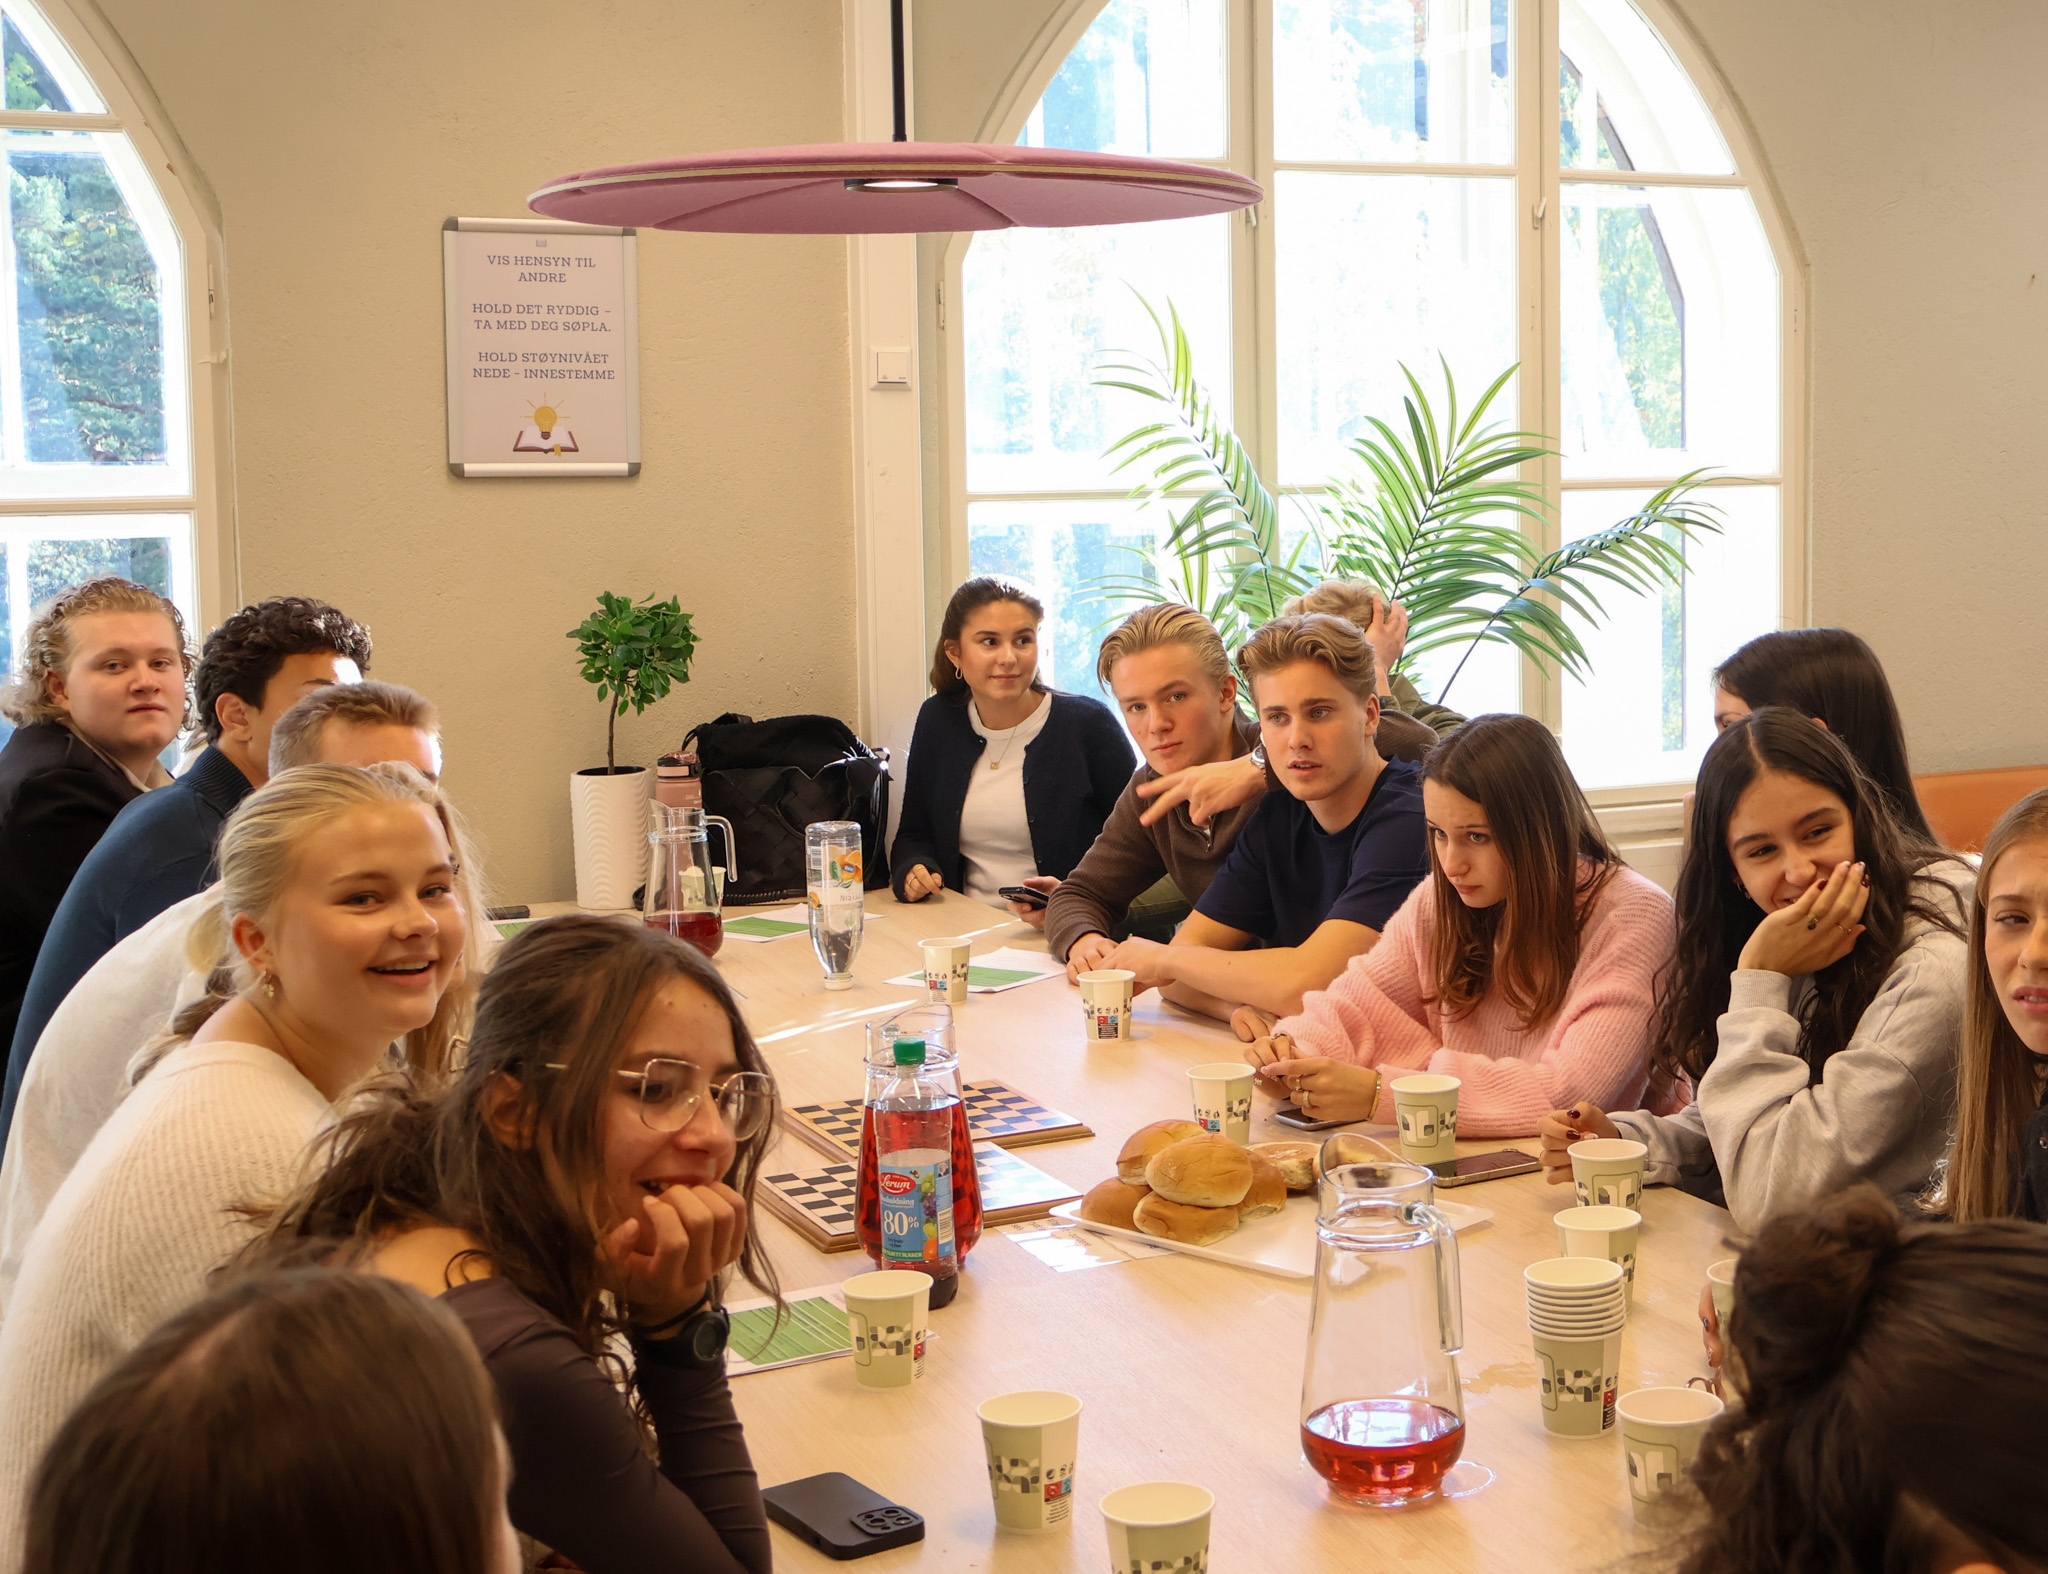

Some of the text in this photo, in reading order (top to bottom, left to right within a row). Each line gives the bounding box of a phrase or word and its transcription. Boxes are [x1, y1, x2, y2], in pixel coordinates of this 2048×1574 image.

[487, 255, 597, 268] VIS HENSYN TIL
[517, 271, 567, 283] ANDRE
[472, 303, 513, 314] HOLD
[515, 304, 543, 315] DET
[546, 305, 600, 316] RYDDIG
[473, 319, 612, 333] TA MED DEG SØPLA.
[478, 351, 609, 364] HOLD STØYNIVÅET
[472, 367, 511, 379] NEDE
[523, 368, 616, 380] INNESTEMME
[881, 1174, 911, 1193] Lerum
[884, 1210, 920, 1236] 80%
